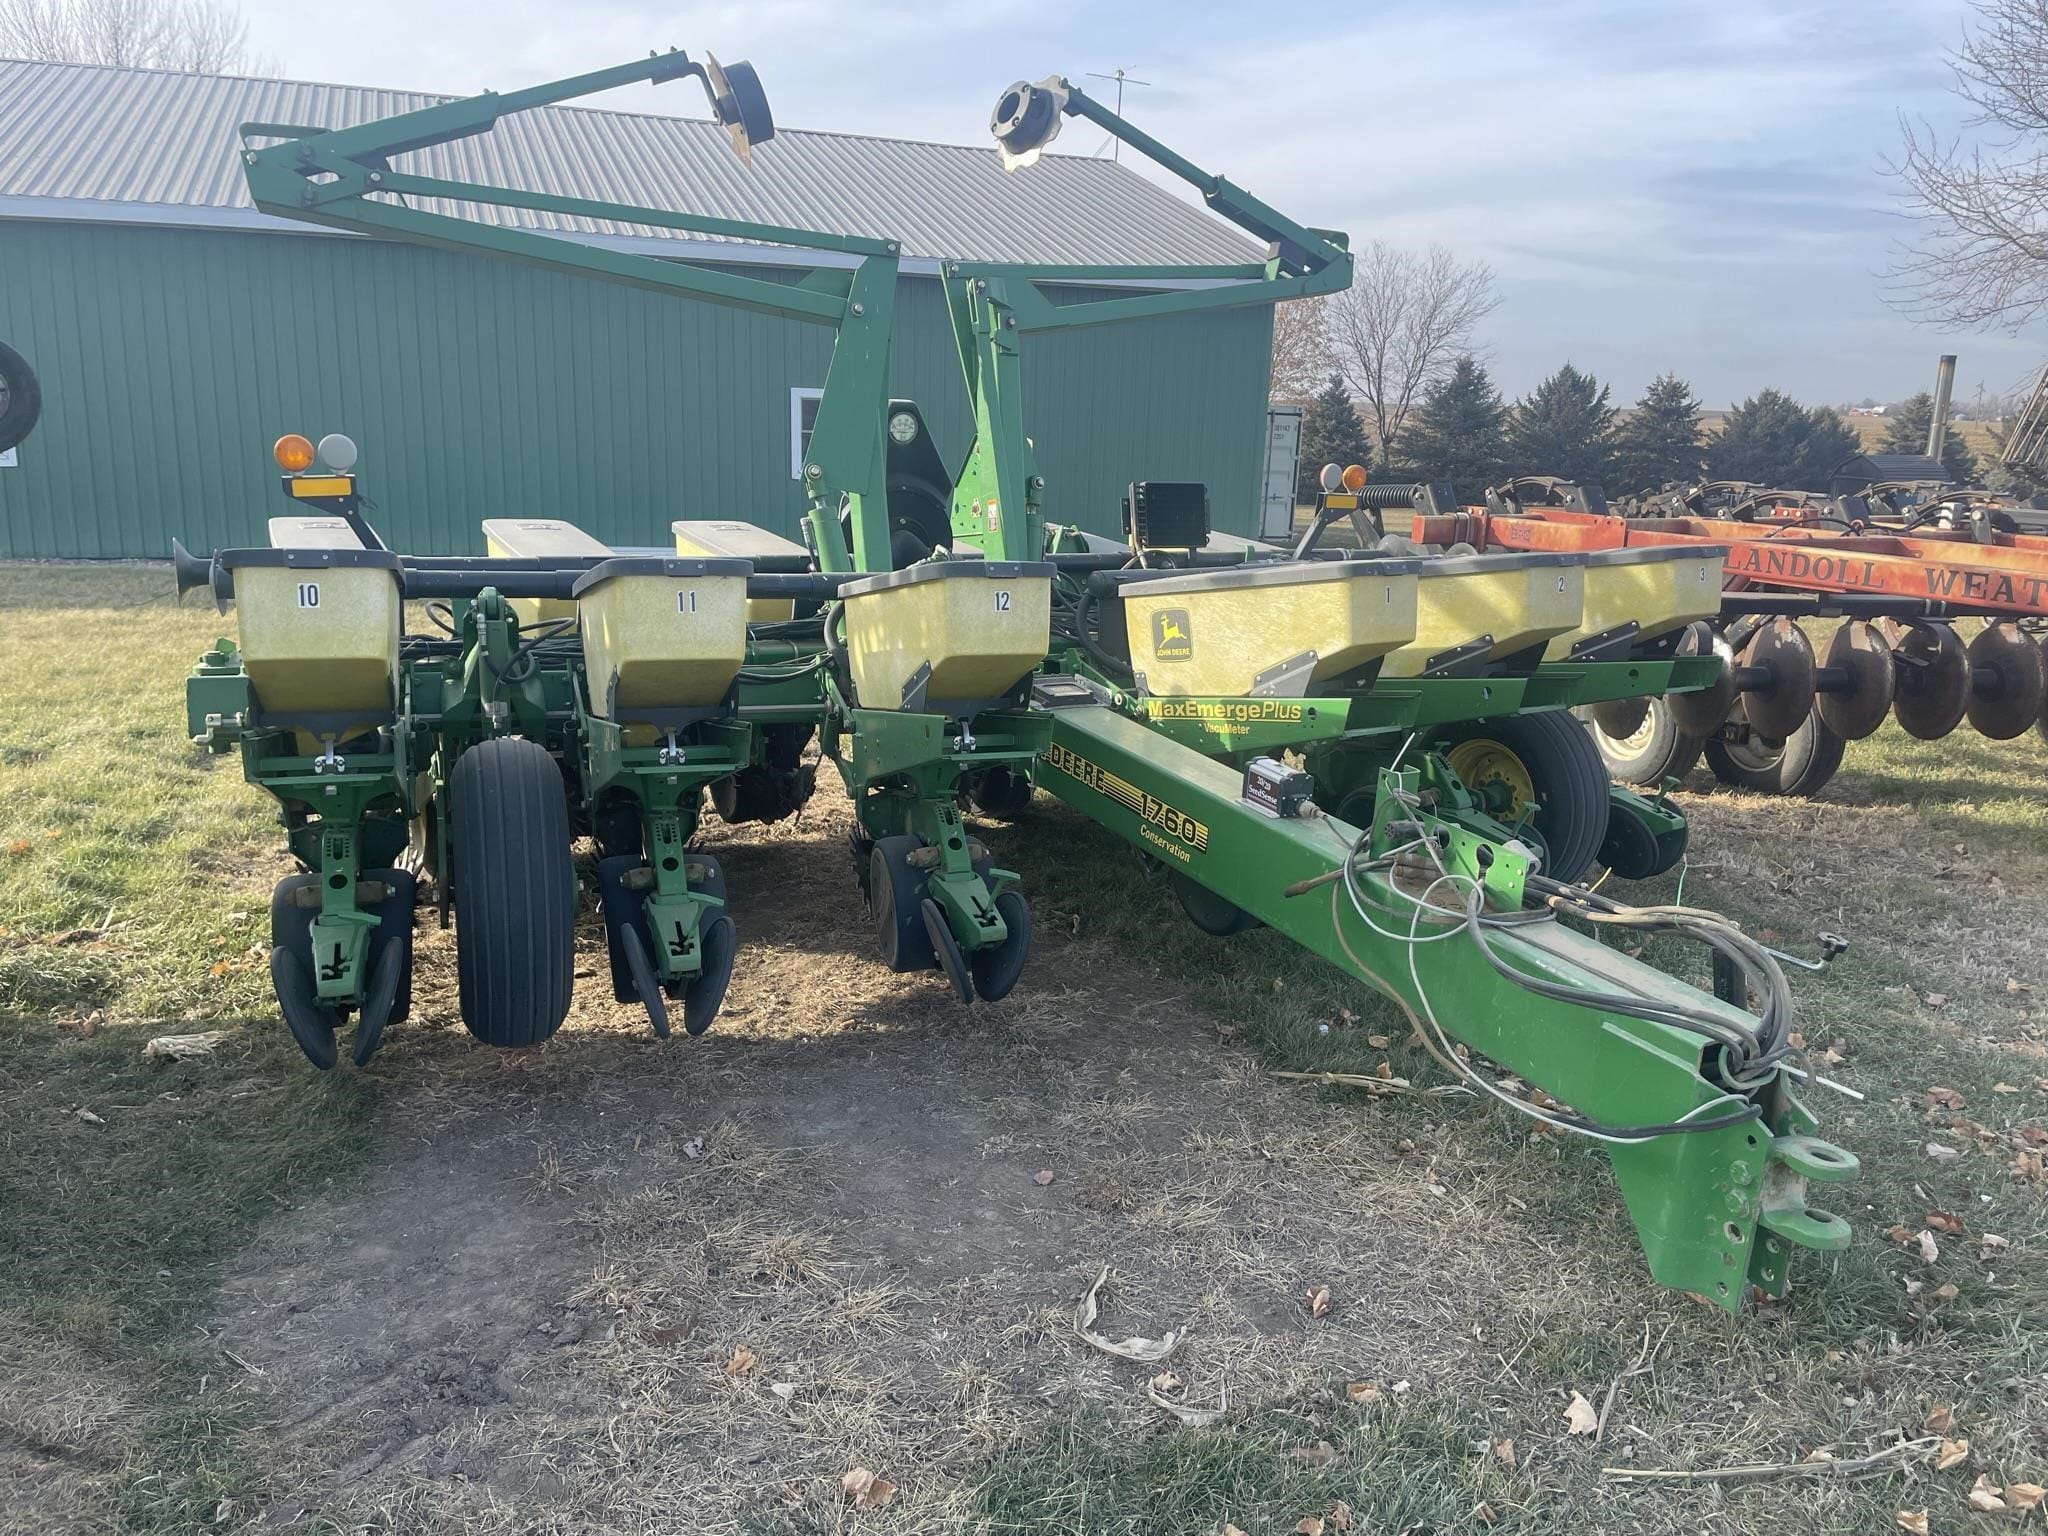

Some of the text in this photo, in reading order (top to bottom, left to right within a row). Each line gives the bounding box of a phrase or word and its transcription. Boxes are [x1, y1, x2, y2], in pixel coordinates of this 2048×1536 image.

[1559, 576, 1564, 592] 2
[1722, 545, 2048, 606] LANDOLL WEAT
[299, 584, 319, 607] 10
[678, 591, 696, 612] 11
[995, 591, 1010, 611] 12
[1157, 647, 1190, 657] JOHN DEERE
[1148, 699, 1303, 722] MaxEmergePlus
[1203, 721, 1250, 735] VacuMeter
[1050, 741, 1198, 847] DEERE 1760
[1256, 775, 1272, 792] 20/20
[1248, 784, 1278, 805] SeedSense
[1139, 823, 1191, 864] Conservation
